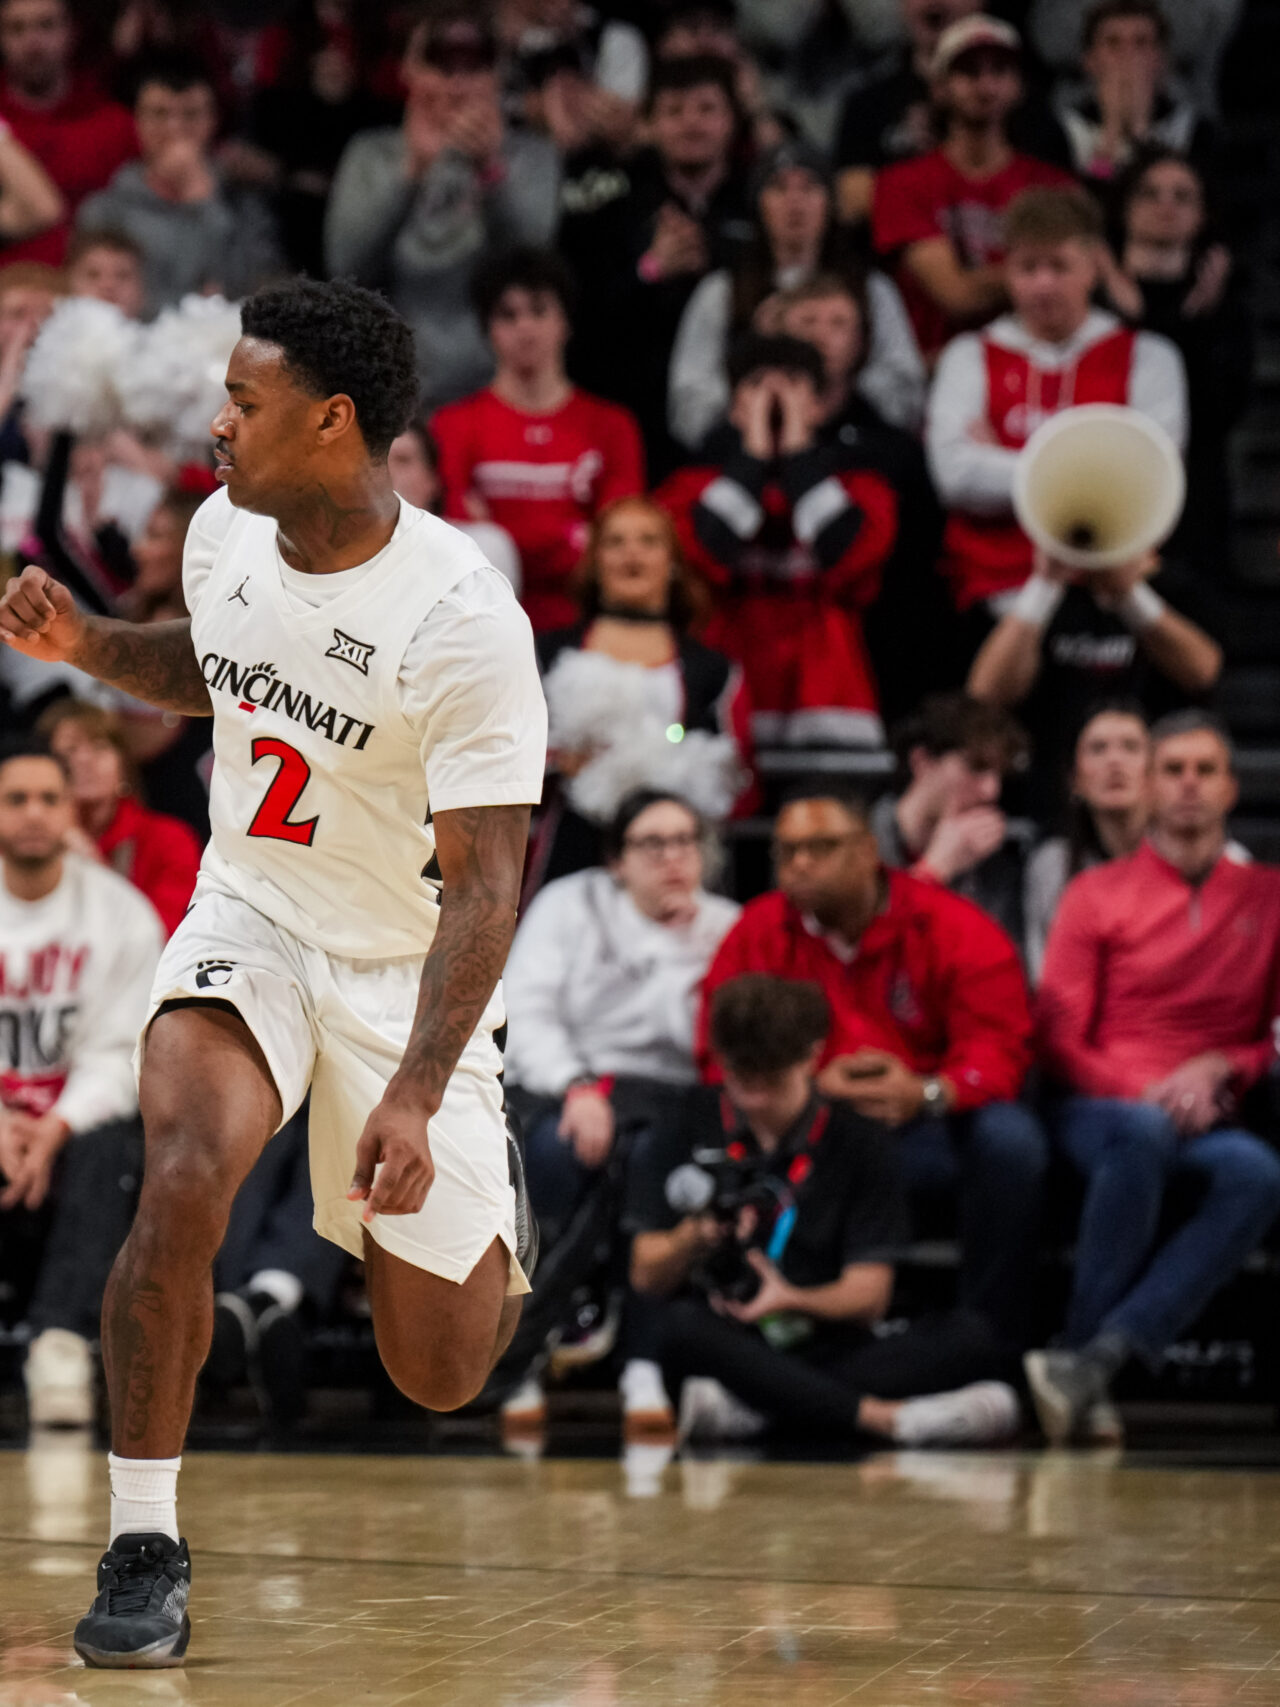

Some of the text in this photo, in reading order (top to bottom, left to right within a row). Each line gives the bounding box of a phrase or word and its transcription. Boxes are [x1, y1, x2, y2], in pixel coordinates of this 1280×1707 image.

[325, 628, 375, 676] XII
[201, 653, 375, 750] CINCINNATI
[247, 737, 320, 847] 2
